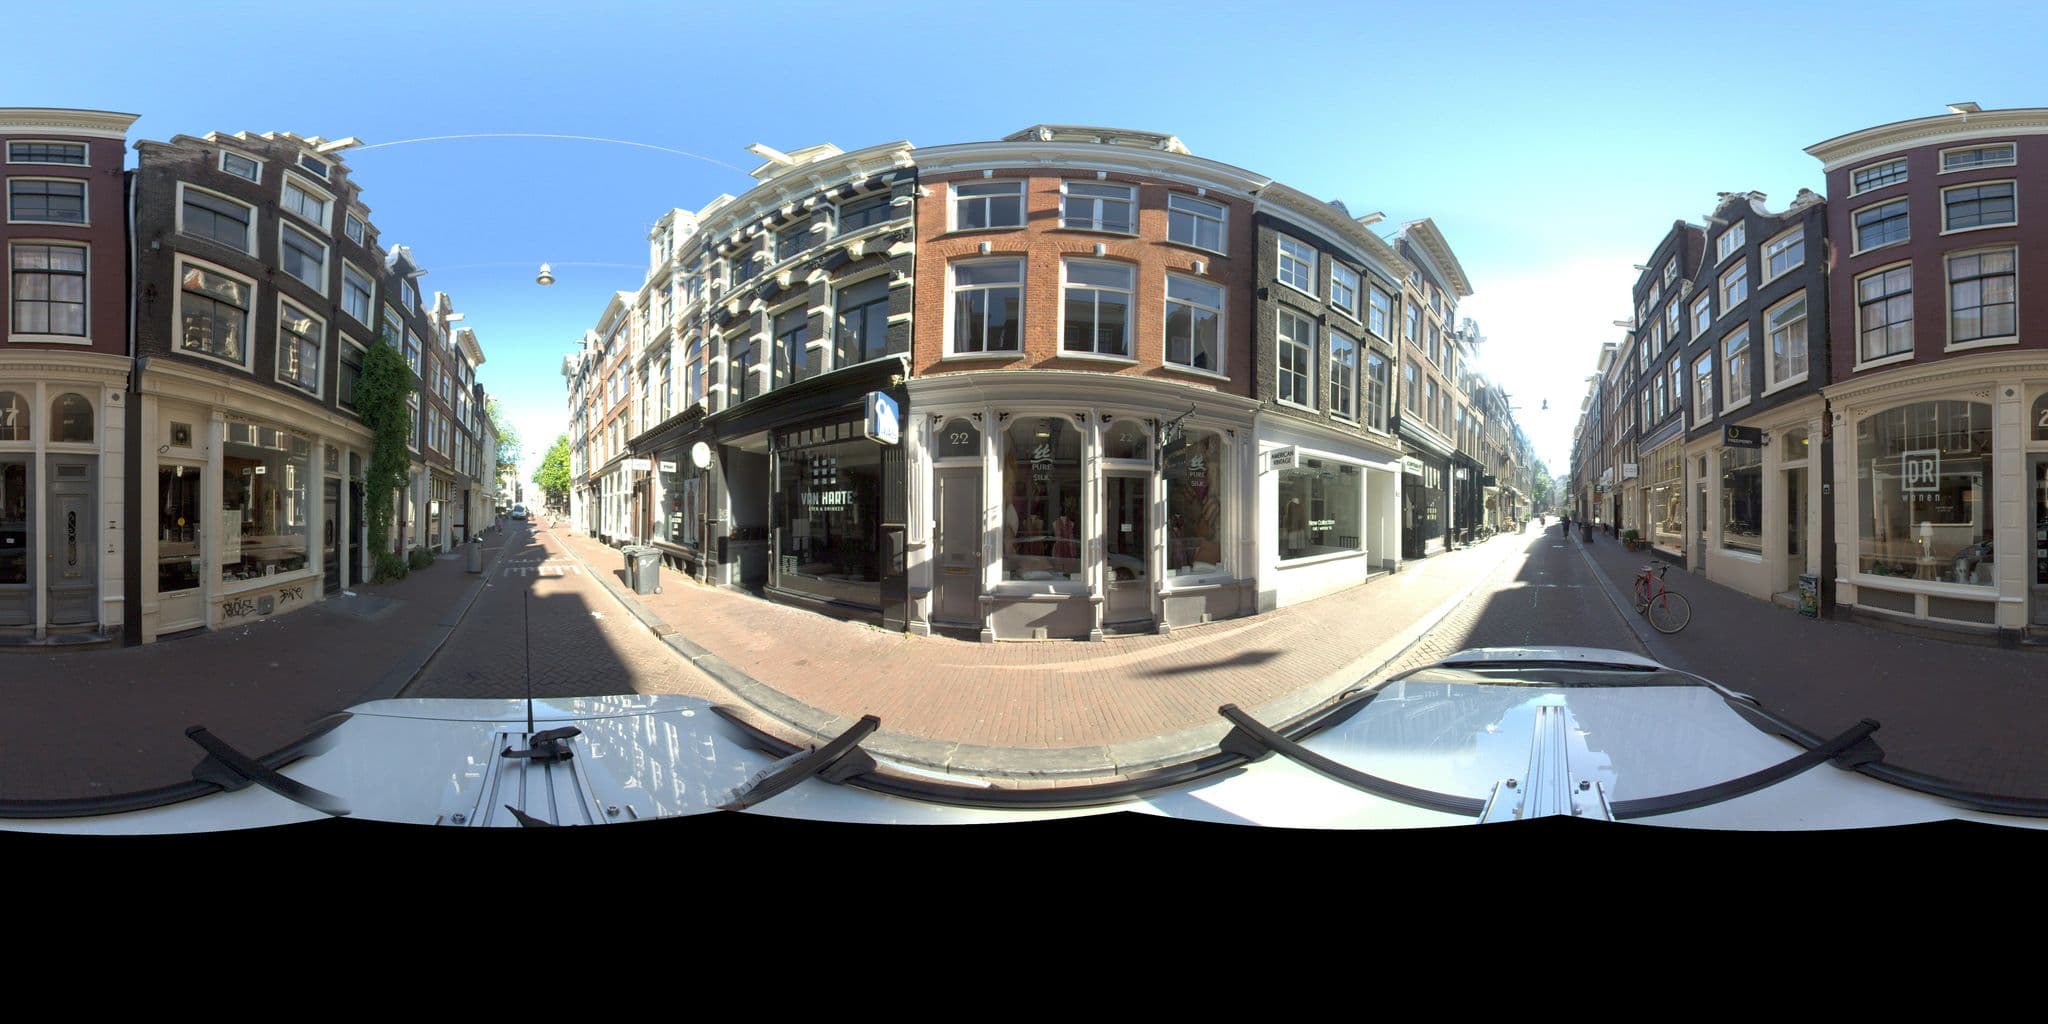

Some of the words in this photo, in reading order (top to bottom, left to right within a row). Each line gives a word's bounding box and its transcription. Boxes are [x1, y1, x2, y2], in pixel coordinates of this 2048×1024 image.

[0, 408, 19, 426] 7
[950, 432, 969, 445] 22
[1119, 433, 1133, 442] 22
[1271, 451, 1294, 459] AMERICAN
[1908, 459, 1934, 484] DR
[801, 492, 819, 505] VAN
[821, 491, 853, 505] HARTE
[1902, 493, 1940, 502] wonen
